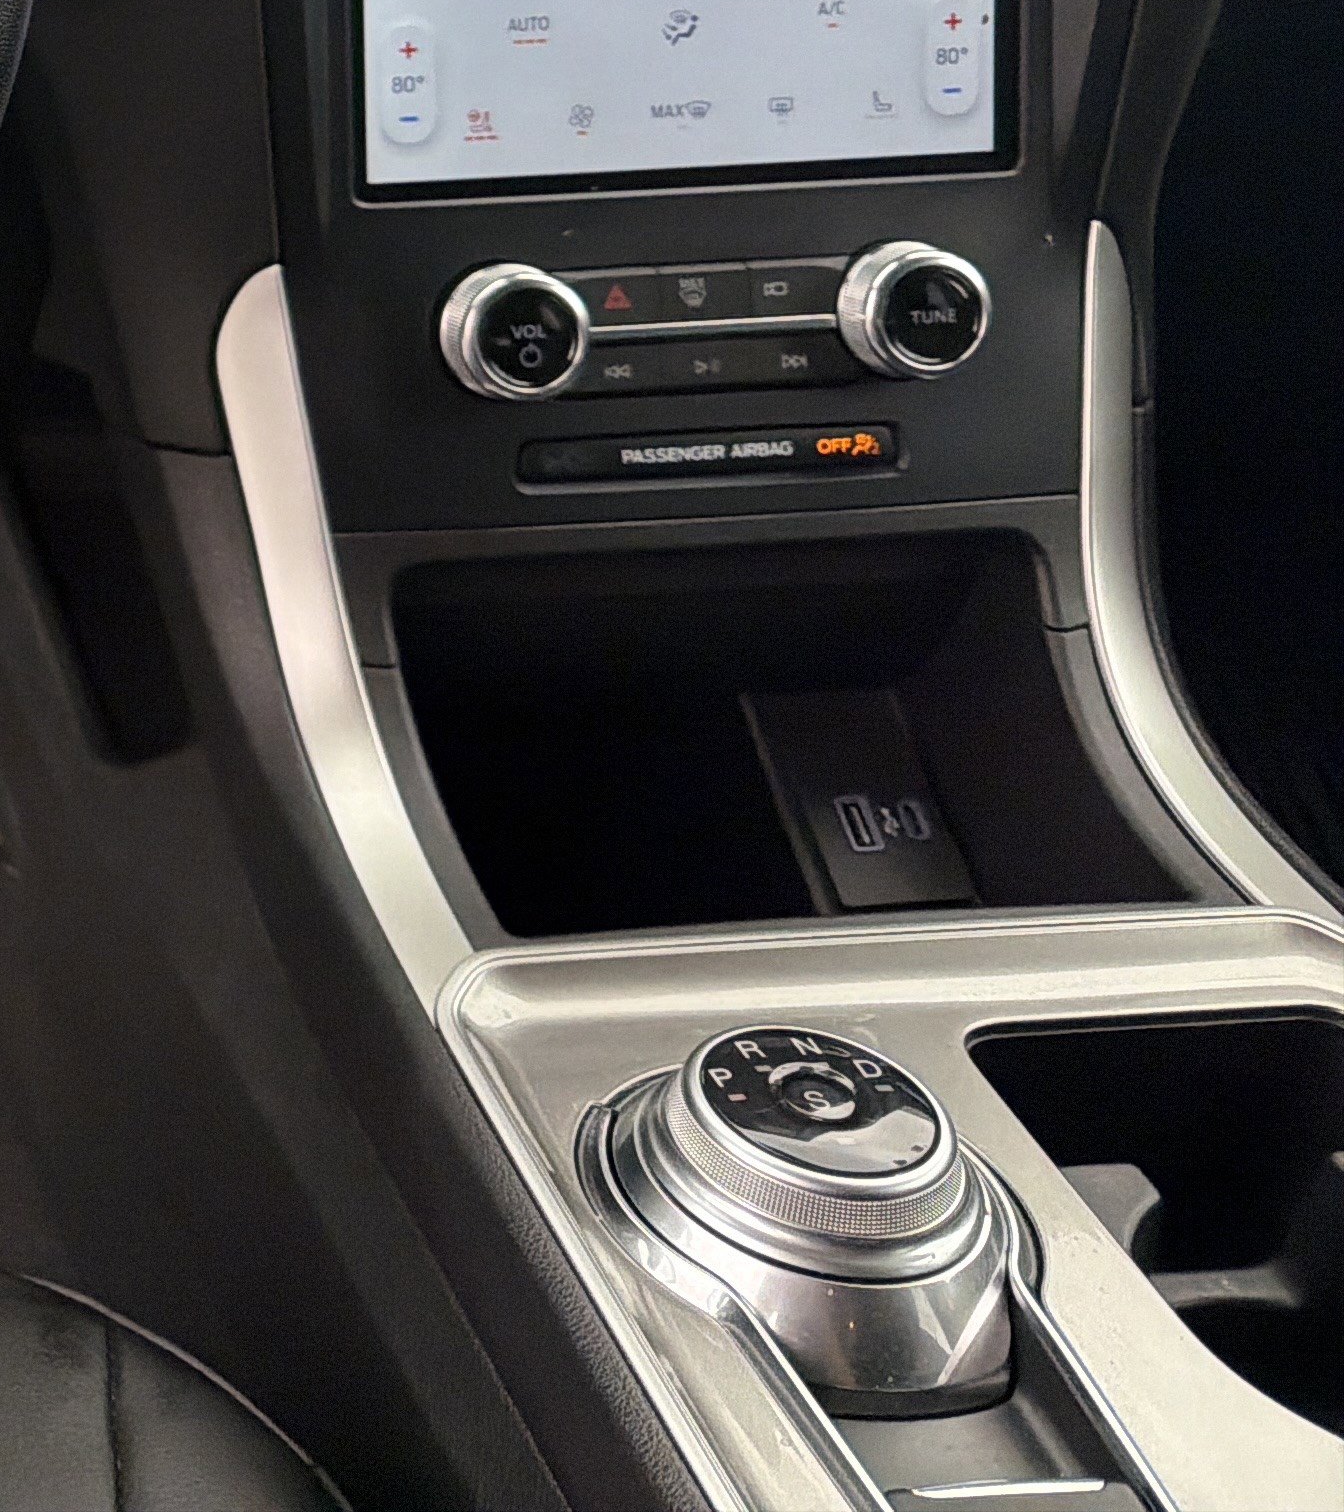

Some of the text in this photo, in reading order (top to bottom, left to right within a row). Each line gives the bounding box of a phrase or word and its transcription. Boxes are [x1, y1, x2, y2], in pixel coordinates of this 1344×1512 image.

[507, 14, 551, 35] AUTO
[935, 46, 969, 67] 80°
[650, 102, 684, 120] MAX
[912, 308, 958, 326] TUNE
[512, 324, 547, 341] VOL
[620, 436, 852, 465] PASSENGER AIRBAG OFF
[734, 1040, 767, 1060] R
[789, 1037, 824, 1056] N
[707, 1067, 733, 1088] P
[852, 1059, 882, 1079] D
